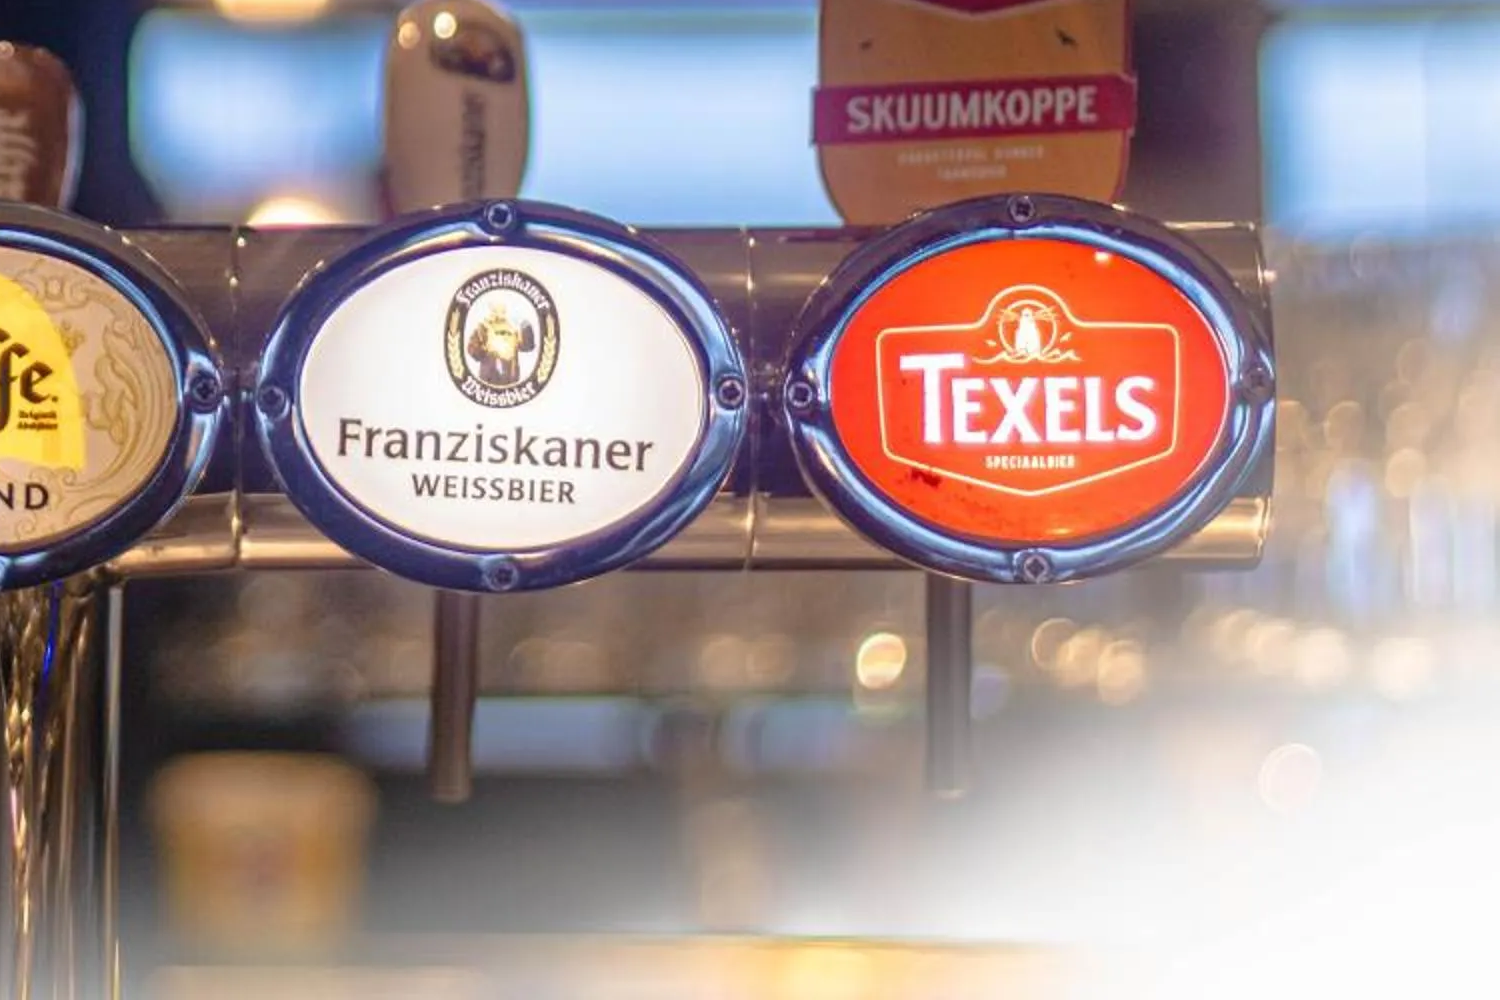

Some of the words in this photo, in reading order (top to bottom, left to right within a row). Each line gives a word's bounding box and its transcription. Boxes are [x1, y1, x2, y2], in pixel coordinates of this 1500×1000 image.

[846, 85, 1097, 135] SKUUMKOPPE
[455, 270, 550, 309] Franziskaner
[899, 352, 1158, 445] TEXELS
[337, 417, 653, 472] Franziskaner
[411, 473, 576, 504] WEISSBIER
